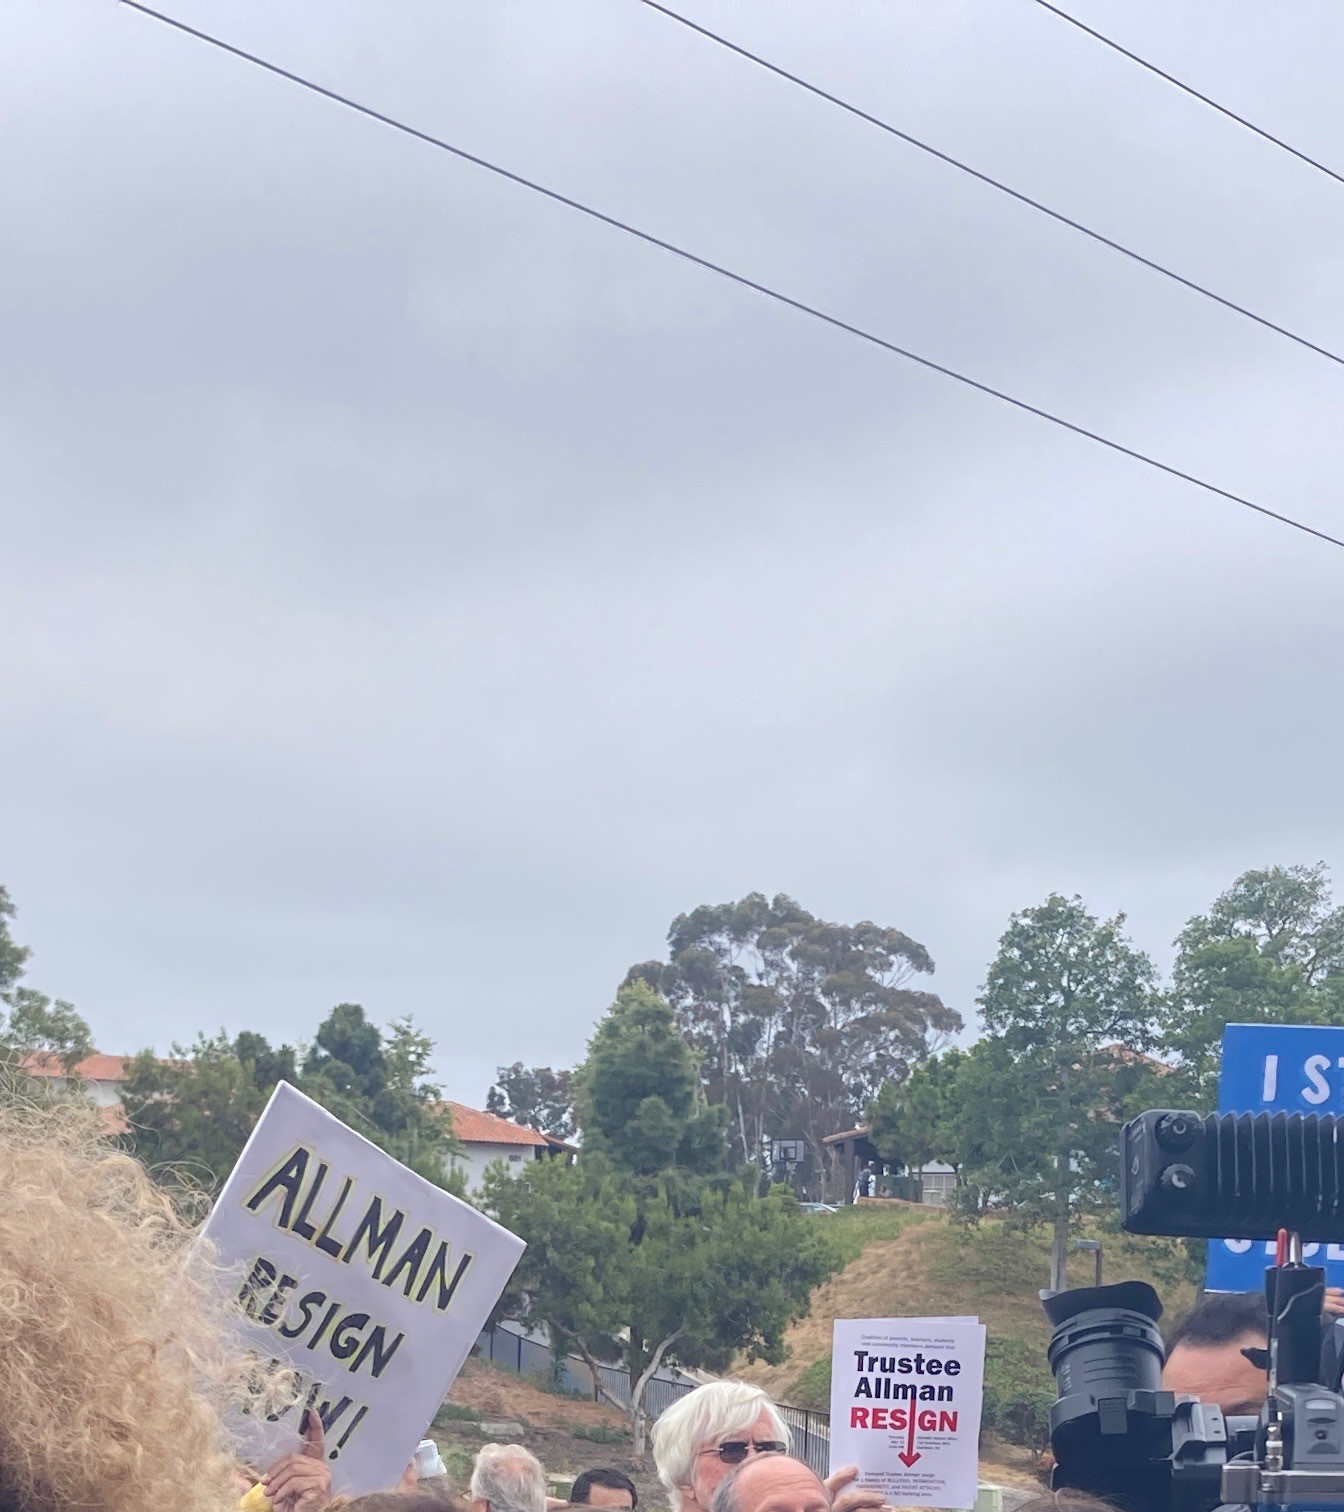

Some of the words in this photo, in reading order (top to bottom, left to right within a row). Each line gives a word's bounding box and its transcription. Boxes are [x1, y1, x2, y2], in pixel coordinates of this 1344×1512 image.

[1262, 1054, 1278, 1102] I
[244, 1145, 473, 1311] ALLMAN
[238, 1257, 405, 1378] RESIGN
[854, 1350, 961, 1376] Trustee
[854, 1377, 953, 1402] Allman
[850, 1407, 959, 1432] RESIGN
